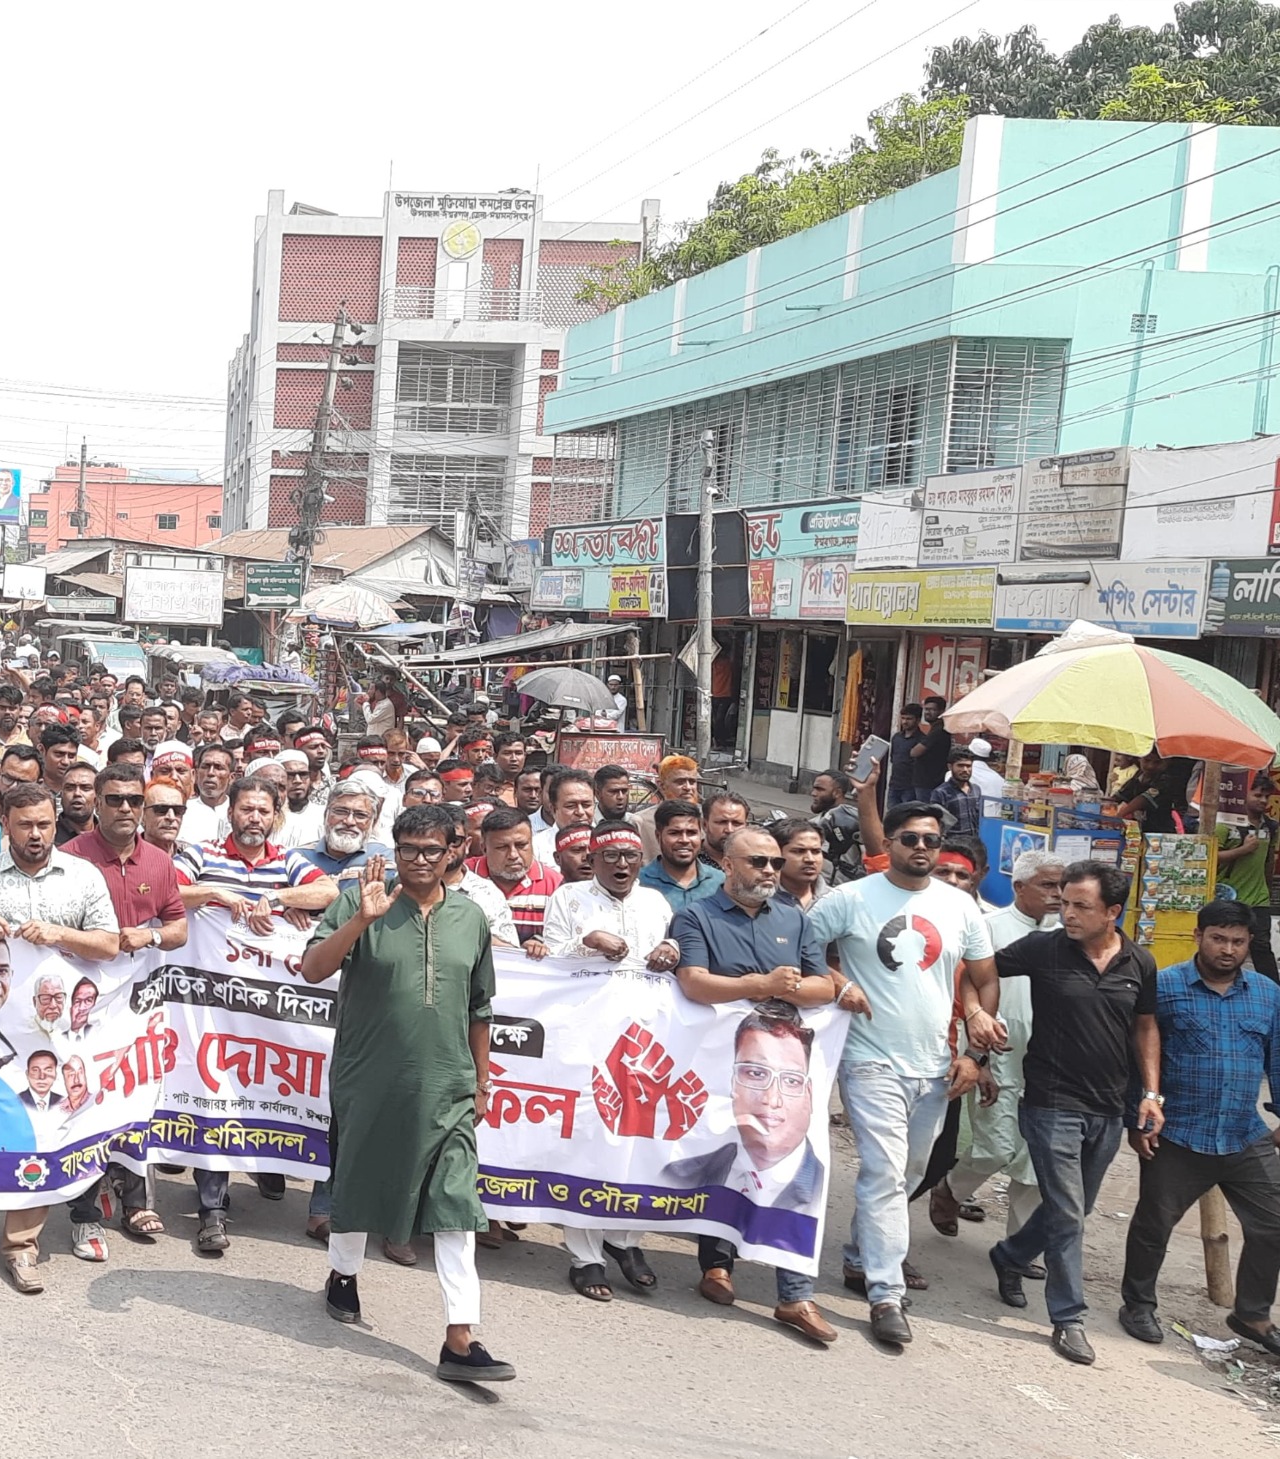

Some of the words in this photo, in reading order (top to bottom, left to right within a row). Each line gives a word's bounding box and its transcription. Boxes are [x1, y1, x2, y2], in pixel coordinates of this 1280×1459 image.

[394, 194, 434, 209] উপজেলা
[514, 199, 535, 210] ভবন
[1097, 579, 1136, 619] শপিং
[1142, 579, 1198, 618] সেন্টার
[226, 939, 273, 968] ১লা
[213, 977, 270, 1010] শ্রমিক
[276, 985, 334, 1022] দিবস
[489, 1024, 533, 1049] ক্ষে
[197, 1032, 327, 1099] দোয়া
[475, 1060, 581, 1139] ফিল
[173, 1091, 189, 1105] পাট
[231, 1095, 255, 1112] দলীয়
[259, 1099, 303, 1120] কার্যালয়,
[306, 1107, 331, 1126] ঈশ্বর
[203, 1118, 318, 1163] শ্রমিকদল,
[477, 1174, 539, 1201] জেলা
[548, 1183, 570, 1202] ও
[579, 1183, 643, 1214] পৌর
[650, 1194, 710, 1216] শাখা
